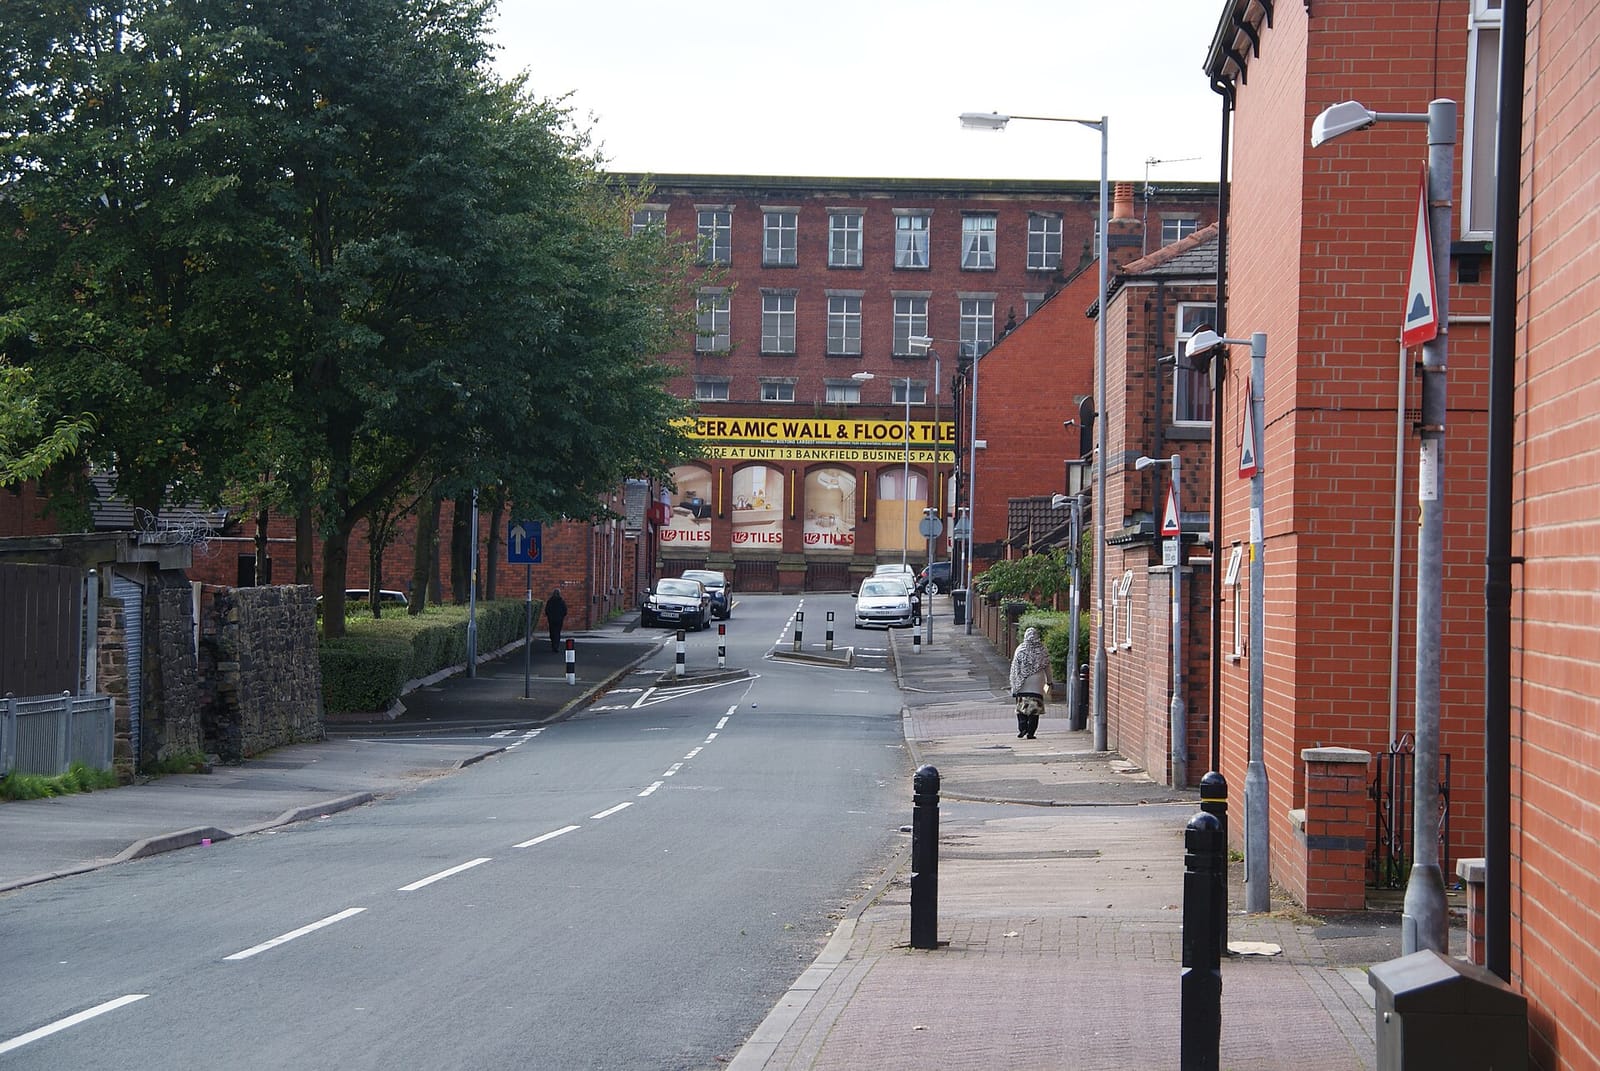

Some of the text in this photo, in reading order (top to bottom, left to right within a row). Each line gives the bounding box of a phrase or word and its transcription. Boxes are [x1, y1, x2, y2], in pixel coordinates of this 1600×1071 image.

[696, 421, 778, 437] CERAMIC
[782, 422, 832, 439] WALL
[836, 424, 848, 439] &
[854, 424, 915, 440] FLOOR
[731, 448, 746, 457] AT
[749, 448, 775, 459] UNIT
[780, 449, 793, 459] 13
[796, 449, 859, 460] BANKFIELD
[678, 531, 711, 542] TILES
[750, 532, 783, 543] TILES
